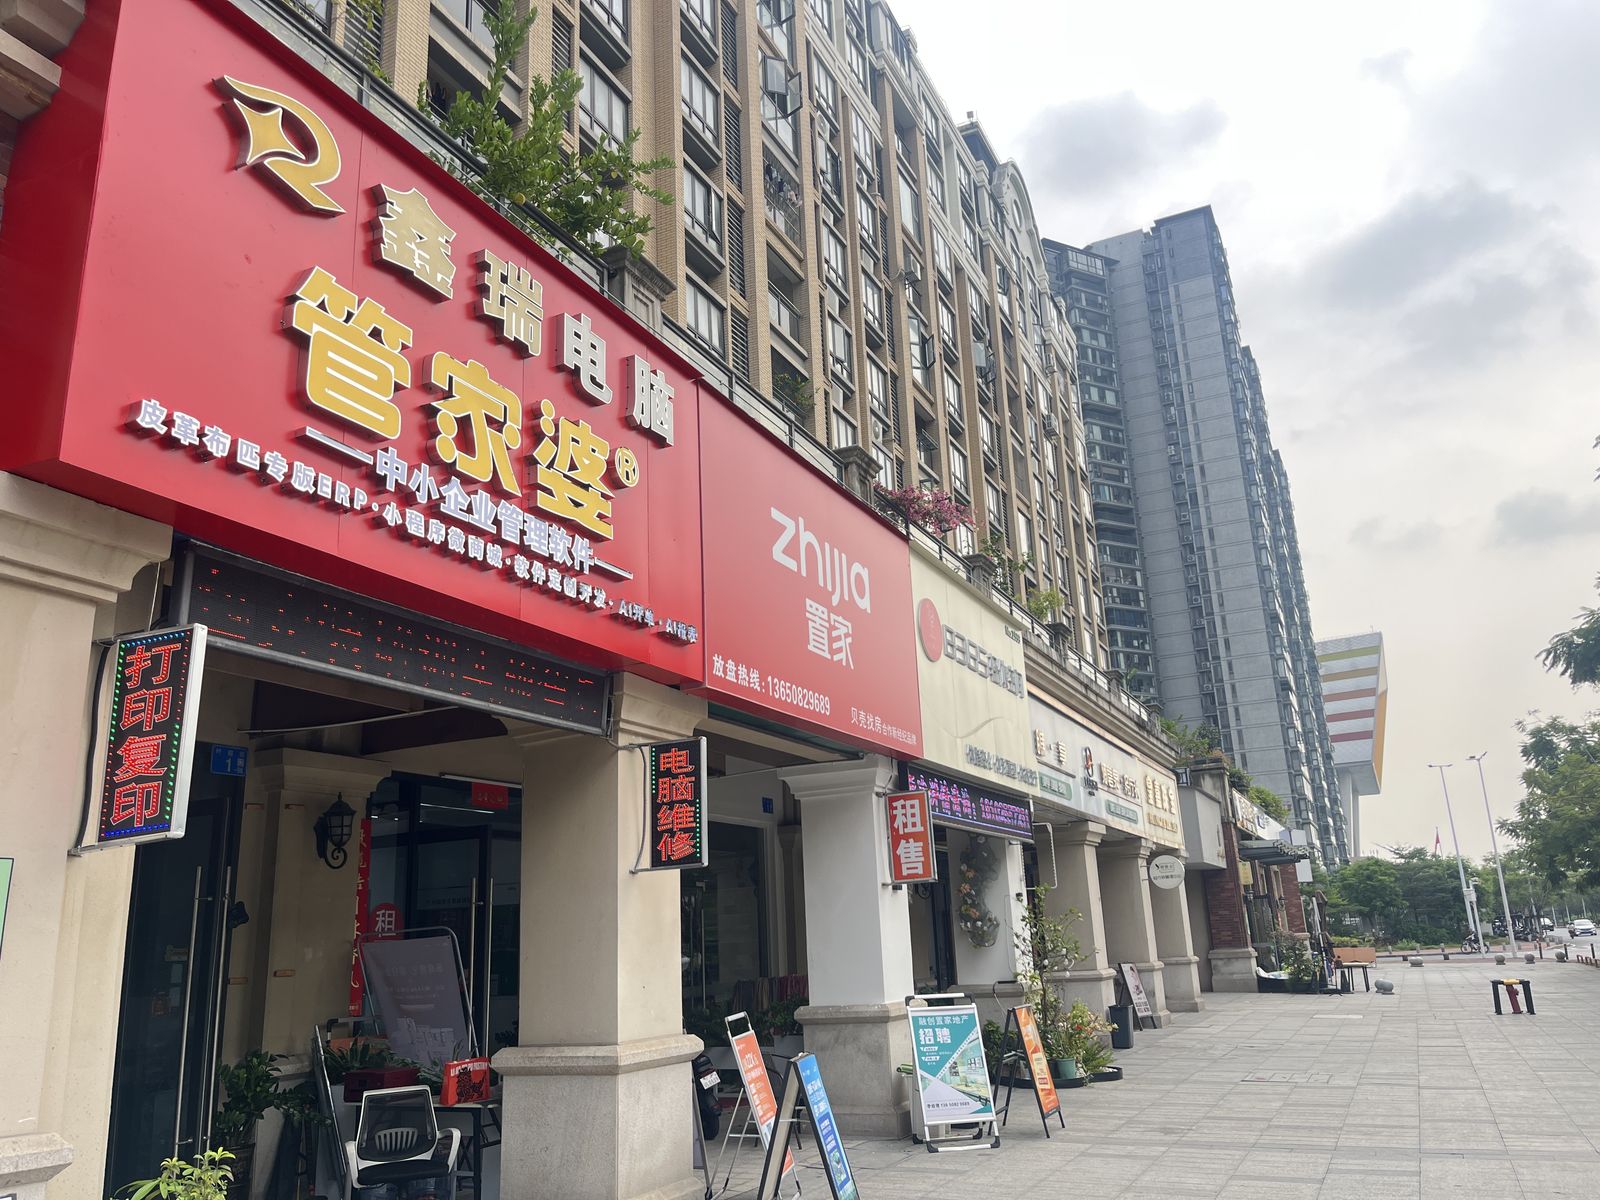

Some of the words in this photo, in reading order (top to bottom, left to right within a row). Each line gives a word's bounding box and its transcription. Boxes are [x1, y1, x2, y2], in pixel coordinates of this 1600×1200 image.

[381, 183, 674, 446] 鑫瑞电脑
[805, 598, 854, 669] 置家
[110, 643, 182, 827] 打印复印
[657, 748, 696, 860] 电脑维修
[892, 799, 924, 876] 租售
[919, 1028, 952, 1045] 招聘
